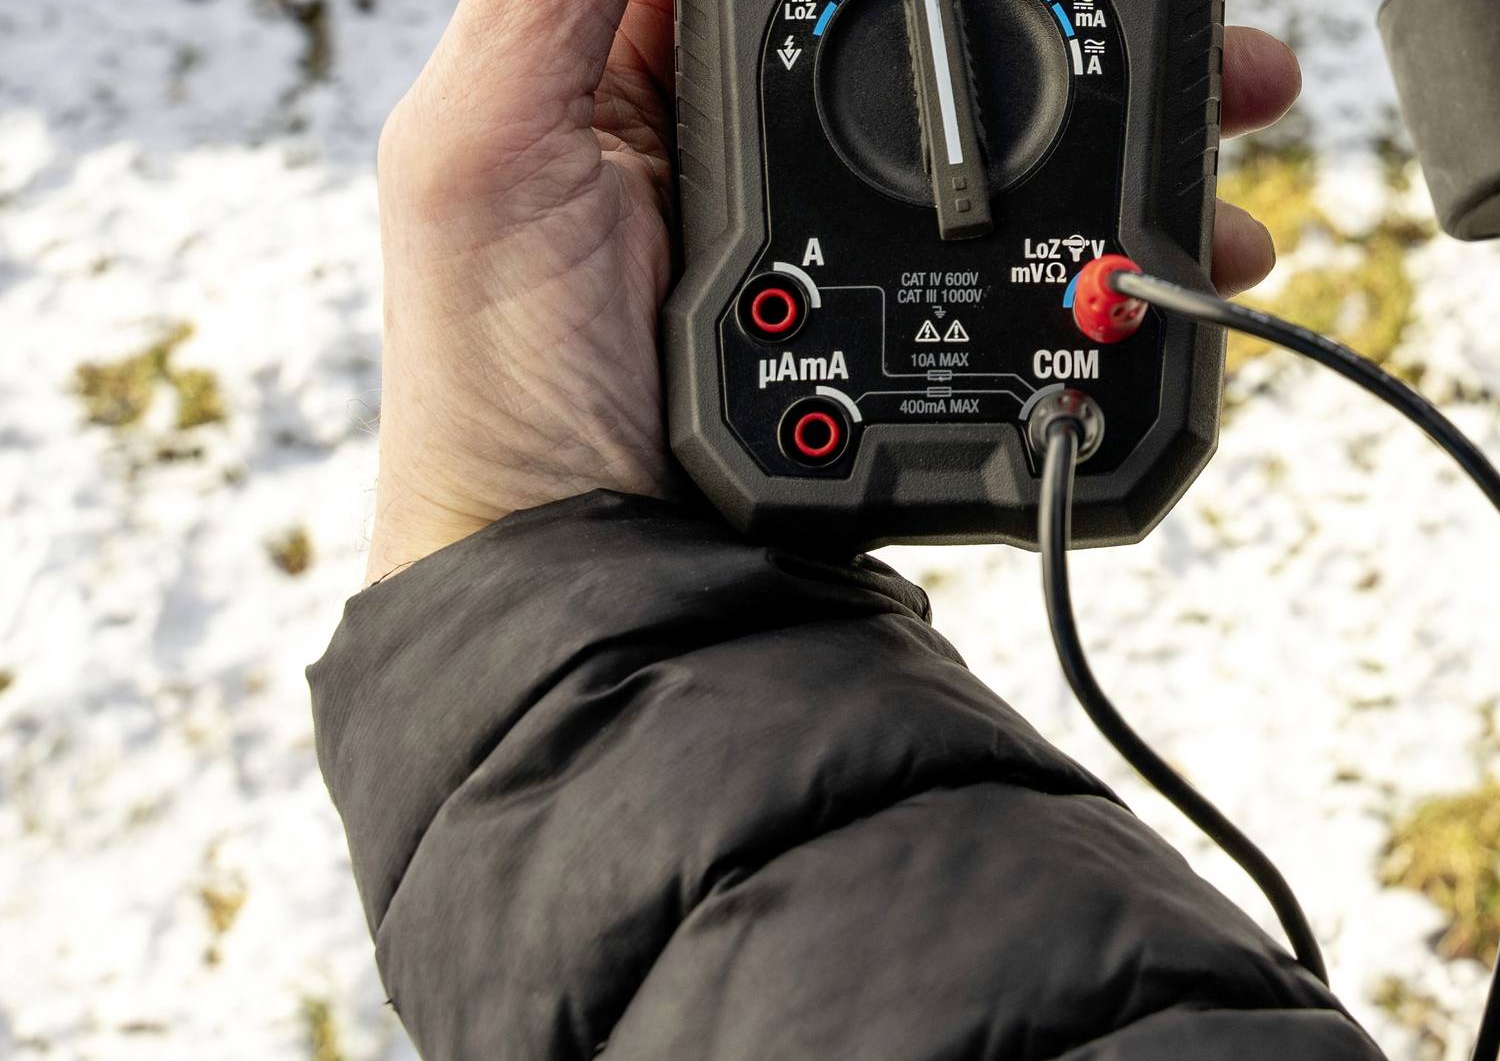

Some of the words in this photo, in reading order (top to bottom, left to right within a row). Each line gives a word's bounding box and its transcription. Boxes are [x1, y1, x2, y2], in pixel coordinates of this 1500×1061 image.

[785, 1, 816, 19] LoZ
[1076, 10, 1106, 27] mA
[1087, 55, 1102, 74] A
[802, 238, 824, 266] A
[1024, 238, 1061, 259] LoZ
[902, 272, 926, 286] CAT
[930, 272, 942, 285] IV
[945, 272, 978, 286] 600V
[898, 289, 922, 303] CAT
[926, 289, 936, 302] III
[942, 289, 982, 303] 1000V
[912, 353, 936, 367] 10A
[940, 353, 968, 366] MAX
[1034, 350, 1098, 379] COM
[900, 399, 946, 414] 400mA
[950, 399, 979, 413] MAX
